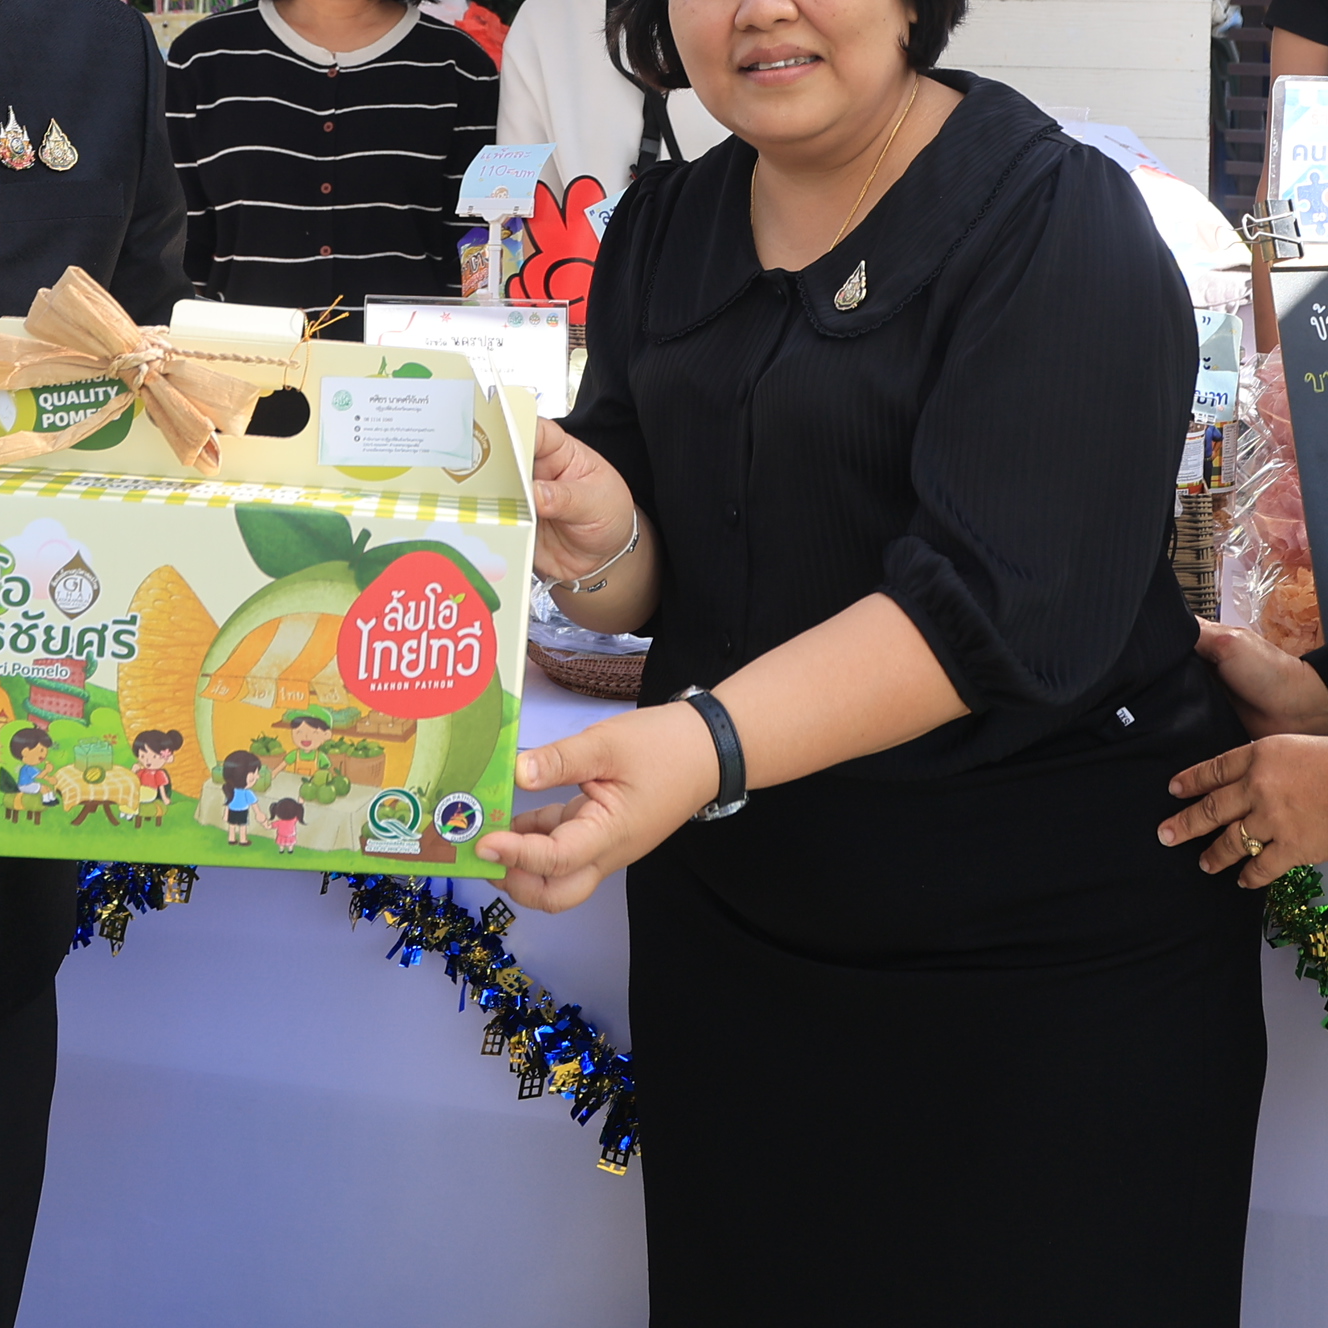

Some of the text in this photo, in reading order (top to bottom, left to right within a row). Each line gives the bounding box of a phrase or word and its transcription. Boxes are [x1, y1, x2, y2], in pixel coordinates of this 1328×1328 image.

[38, 385, 120, 411] QUALITY
[63, 576, 84, 593] GI
[356, 617, 484, 681] ไทยทวี
[12, 661, 70, 680] Pomelo
[370, 679, 455, 692] NAKHON PATHOM
